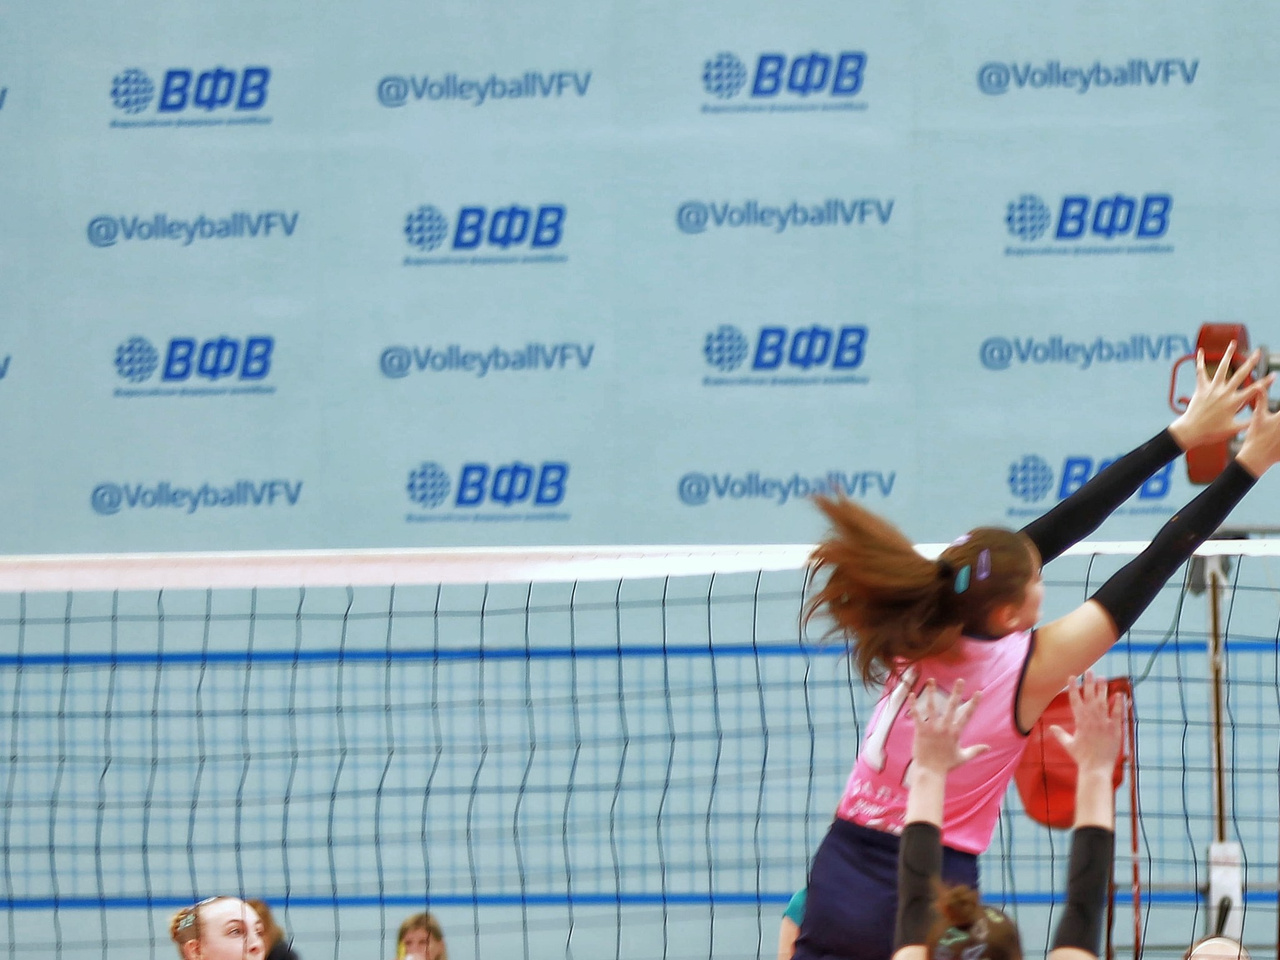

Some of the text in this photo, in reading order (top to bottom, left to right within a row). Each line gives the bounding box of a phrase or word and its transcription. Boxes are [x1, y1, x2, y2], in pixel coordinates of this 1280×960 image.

[156, 66, 271, 112] ВФВ
[377, 72, 591, 107] @VolleyballVFV
[747, 51, 867, 97] ВФВ
[978, 60, 1198, 94] @VolleyballVFV
[87, 212, 298, 247] @VolleyballVFV
[453, 204, 566, 250] ВФВ
[676, 199, 893, 233] @VolleyballVFV
[1055, 193, 1172, 240] ВФВ
[163, 336, 274, 381] ВФВ
[380, 344, 593, 378] @VolleyballVFV
[753, 325, 868, 370] ВФВ
[91, 481, 302, 514] @VolleyballVFV
[456, 462, 569, 507] ВФВ
